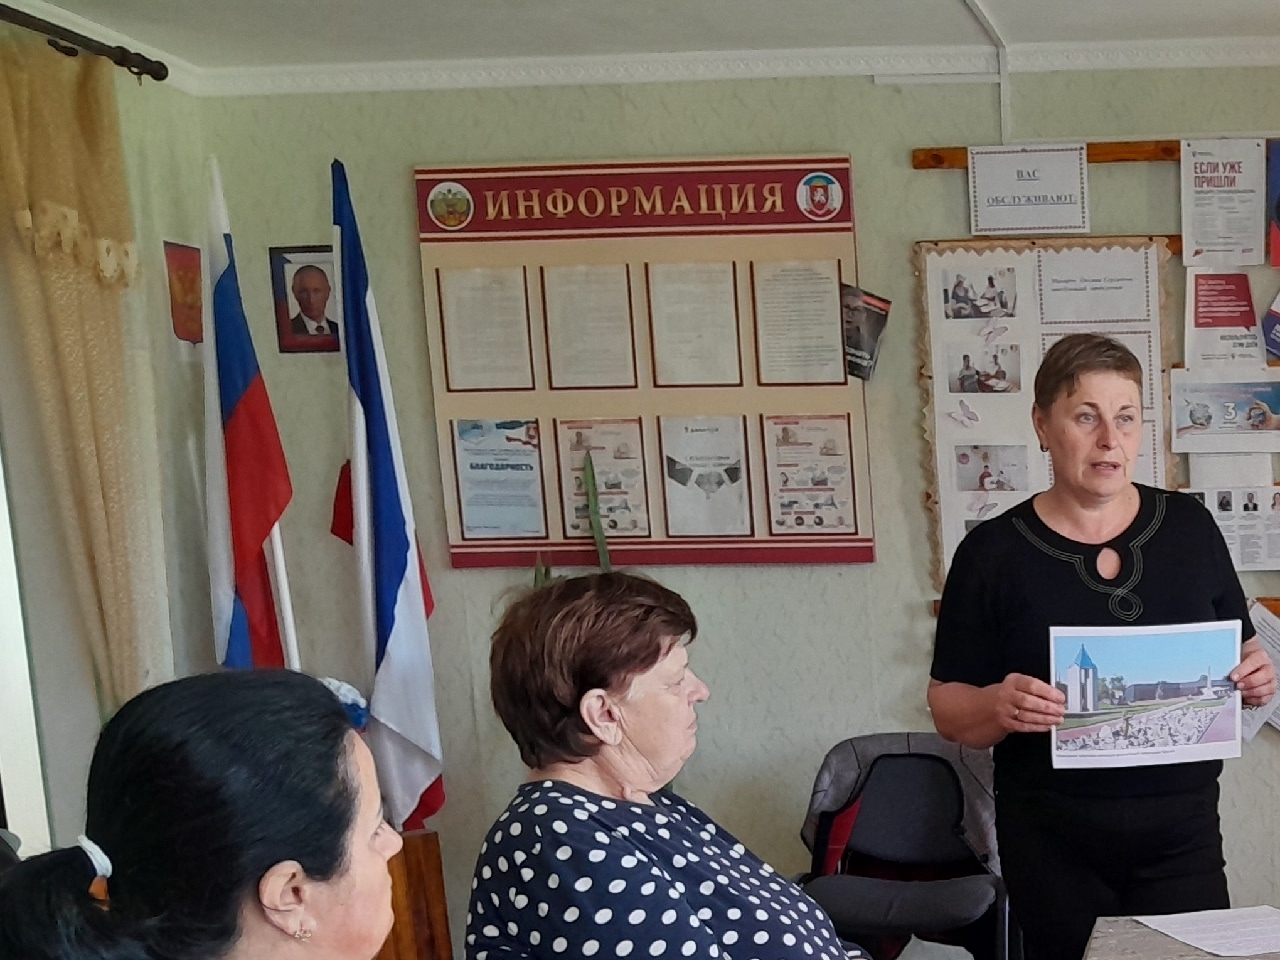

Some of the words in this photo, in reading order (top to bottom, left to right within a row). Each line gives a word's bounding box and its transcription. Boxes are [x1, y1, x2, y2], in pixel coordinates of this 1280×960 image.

[1194, 162, 1219, 174] ЕСЛИ
[1222, 161, 1243, 174] УЖЕ
[1016, 169, 1040, 181] ВАС
[1194, 176, 1236, 188] ПРИШЛИ
[484, 182, 786, 221] ИНФОРМАЦИЯ
[1223, 402, 1237, 420] 3
